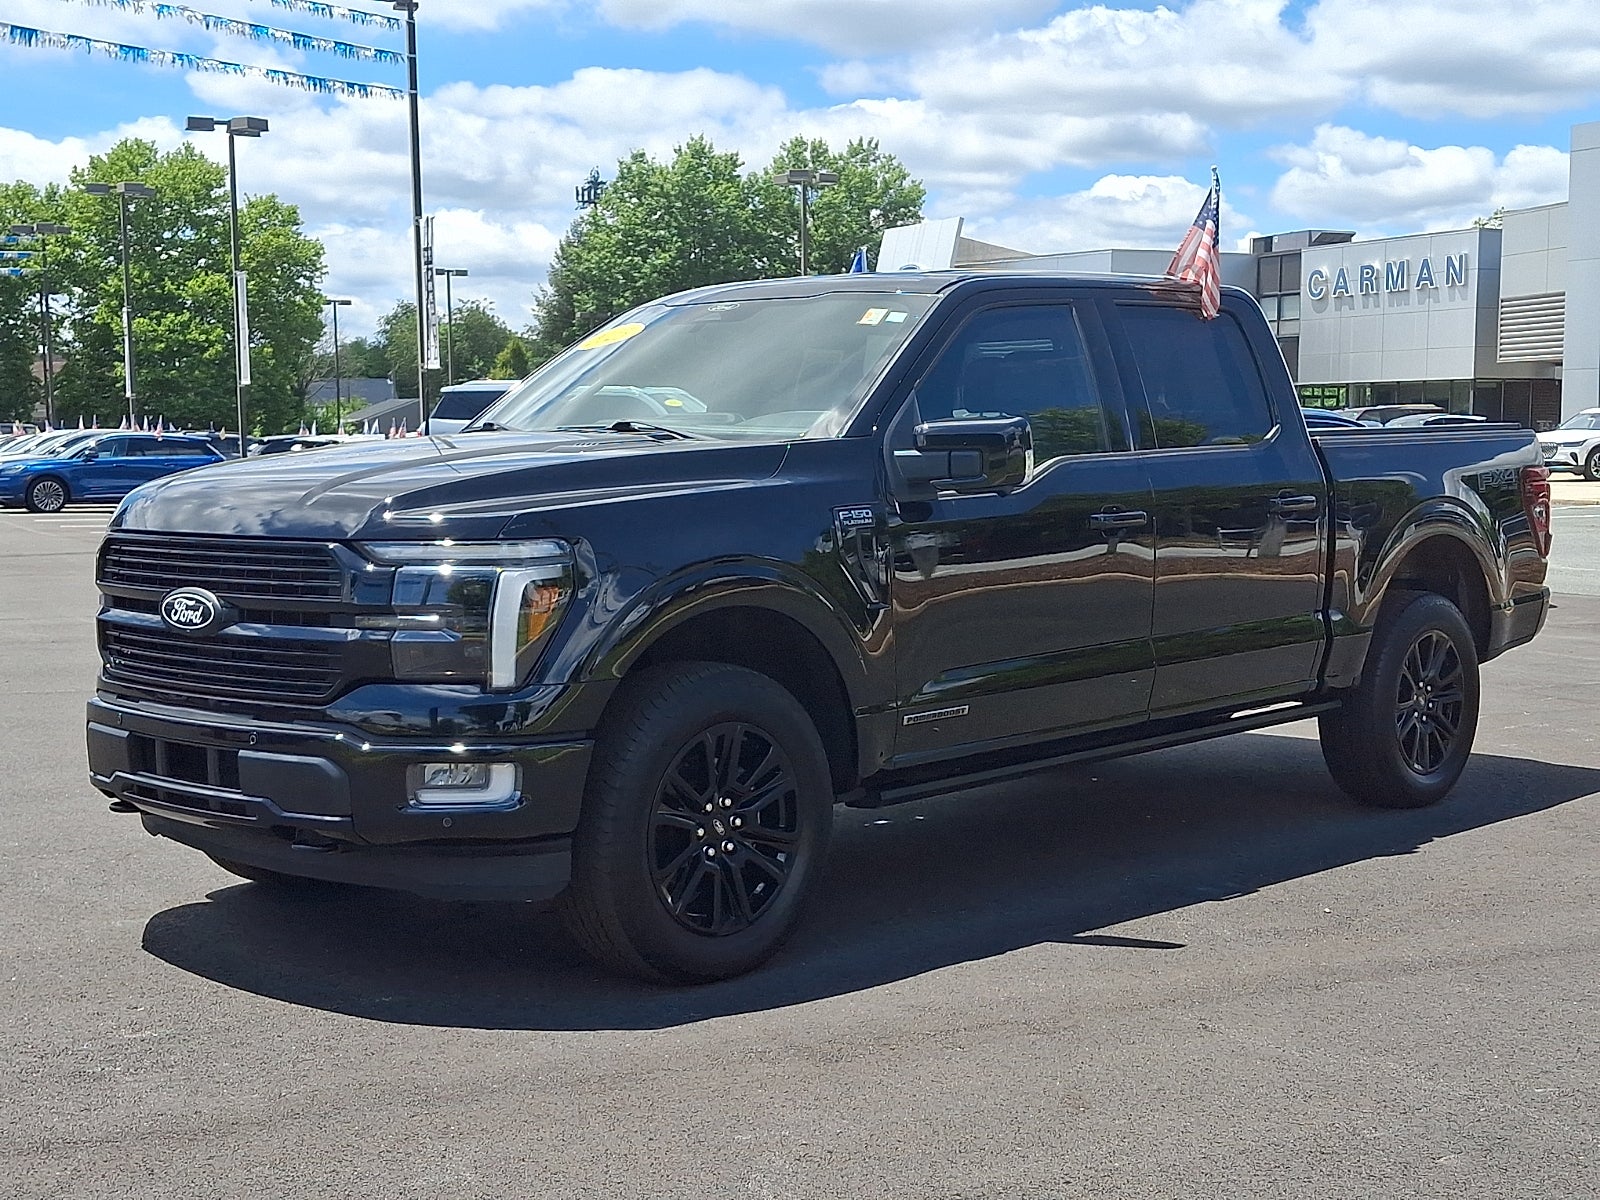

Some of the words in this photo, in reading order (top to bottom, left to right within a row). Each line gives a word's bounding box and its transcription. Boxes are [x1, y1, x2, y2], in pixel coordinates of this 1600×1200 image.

[1307, 252, 1467, 300] CARMAN
[1478, 469, 1517, 492] FX4
[839, 509, 873, 520] F-150
[843, 518, 873, 526] PLATINUM
[170, 597, 204, 624] Ford
[904, 706, 968, 724] POWERBOOST
